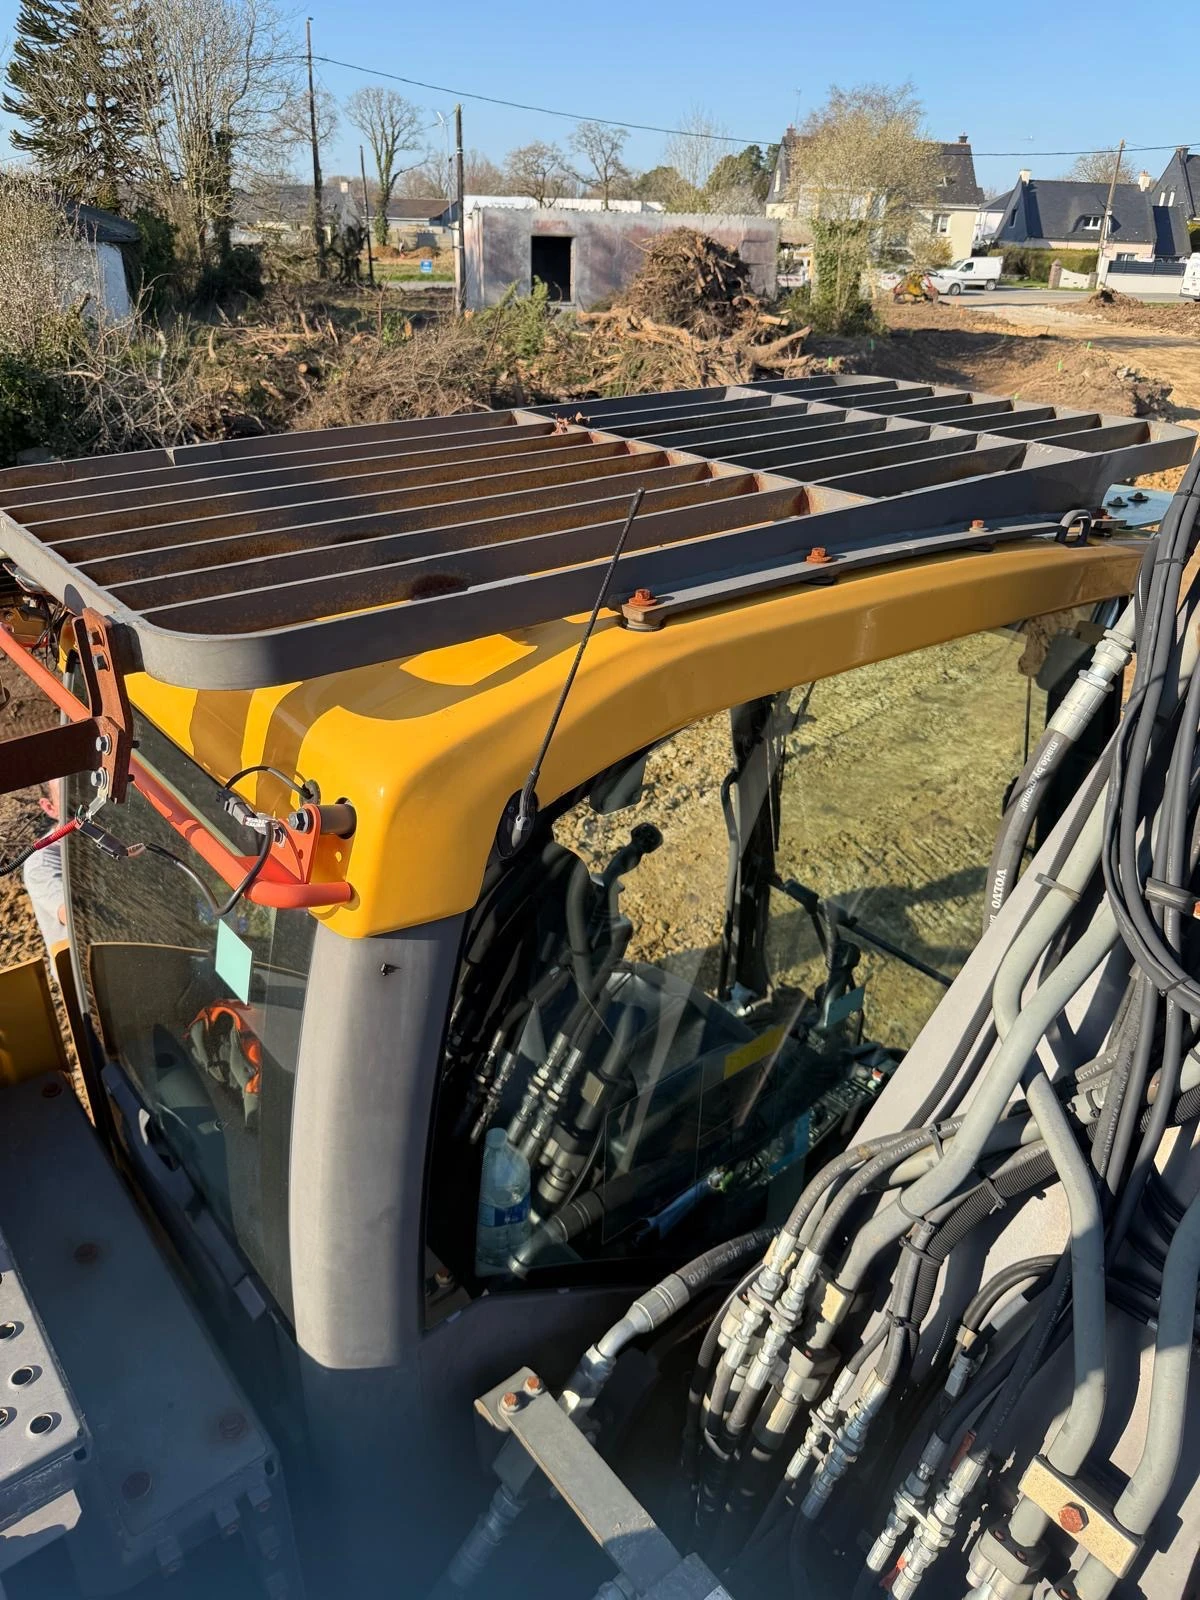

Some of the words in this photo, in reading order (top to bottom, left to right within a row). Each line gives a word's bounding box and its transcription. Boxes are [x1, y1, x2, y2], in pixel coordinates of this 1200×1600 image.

[1040, 740, 1058, 767] made
[1032, 765, 1046, 782] by
[991, 868, 1008, 909] VOLVO
